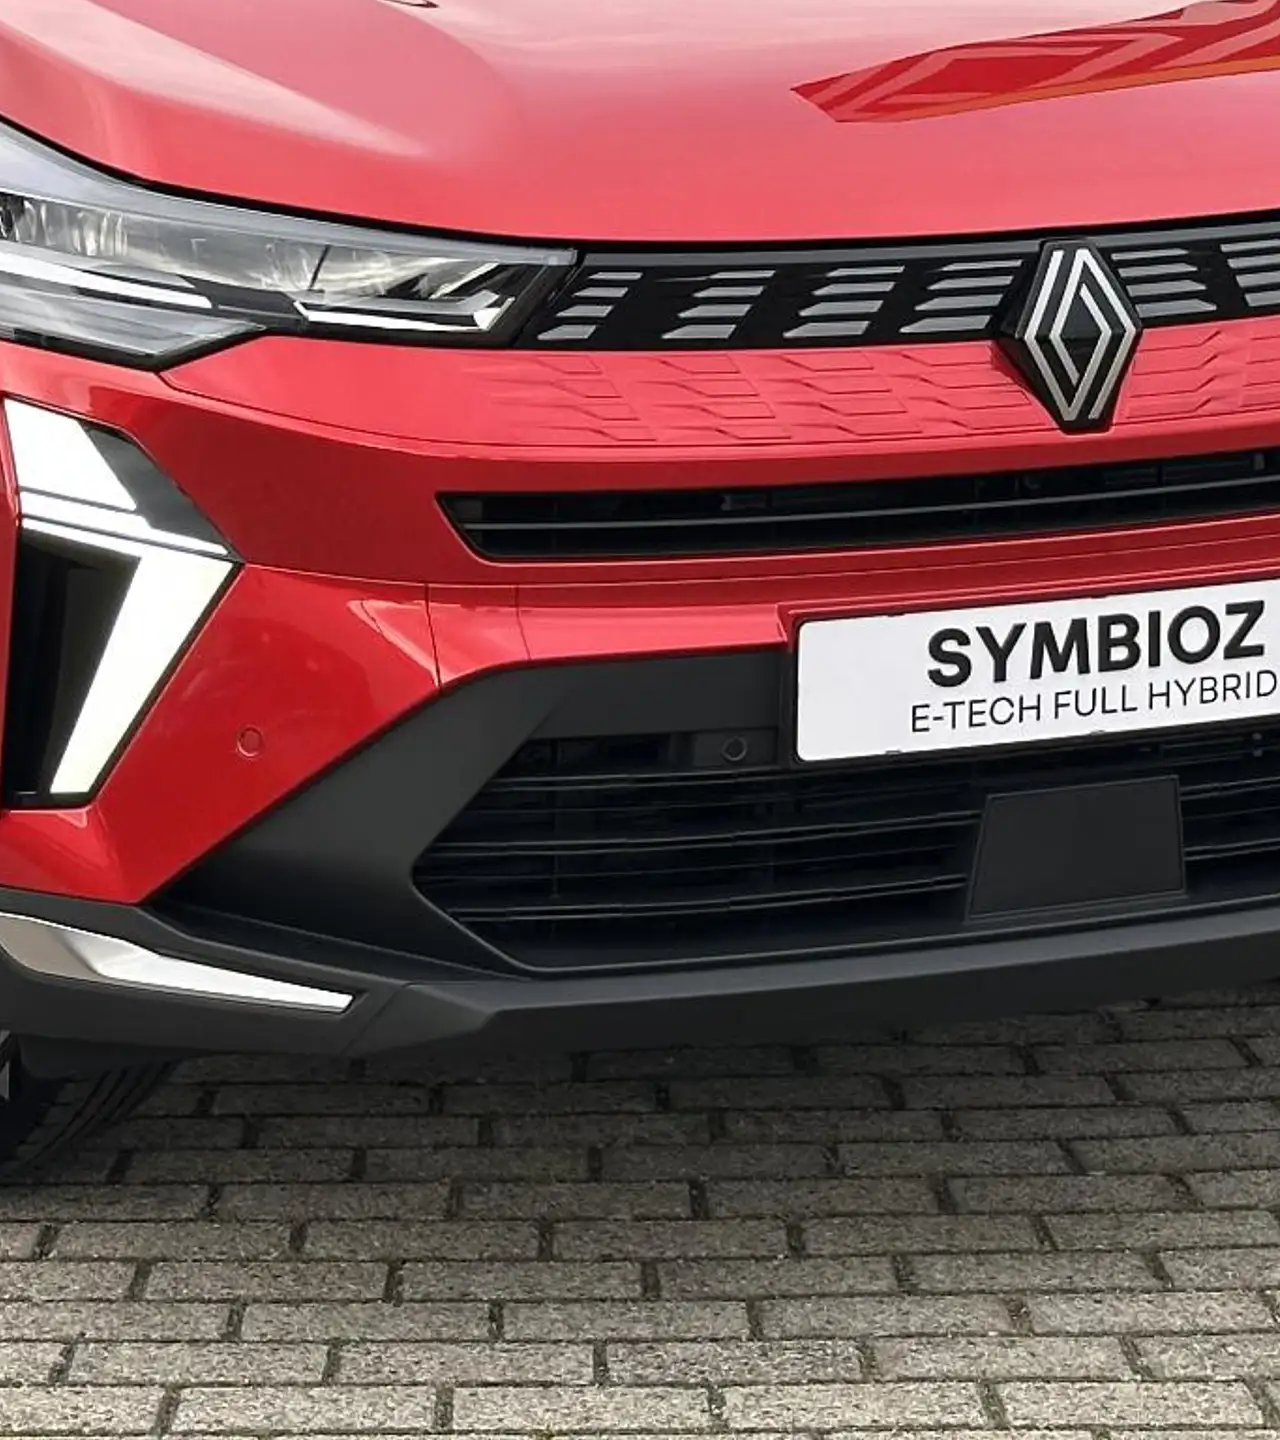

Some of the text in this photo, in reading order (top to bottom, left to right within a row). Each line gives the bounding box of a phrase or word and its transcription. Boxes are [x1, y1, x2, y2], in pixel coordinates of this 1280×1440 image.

[927, 599, 1265, 688] SYMBIOZ
[911, 669, 1278, 733] E-TECH FULL HYBRID
